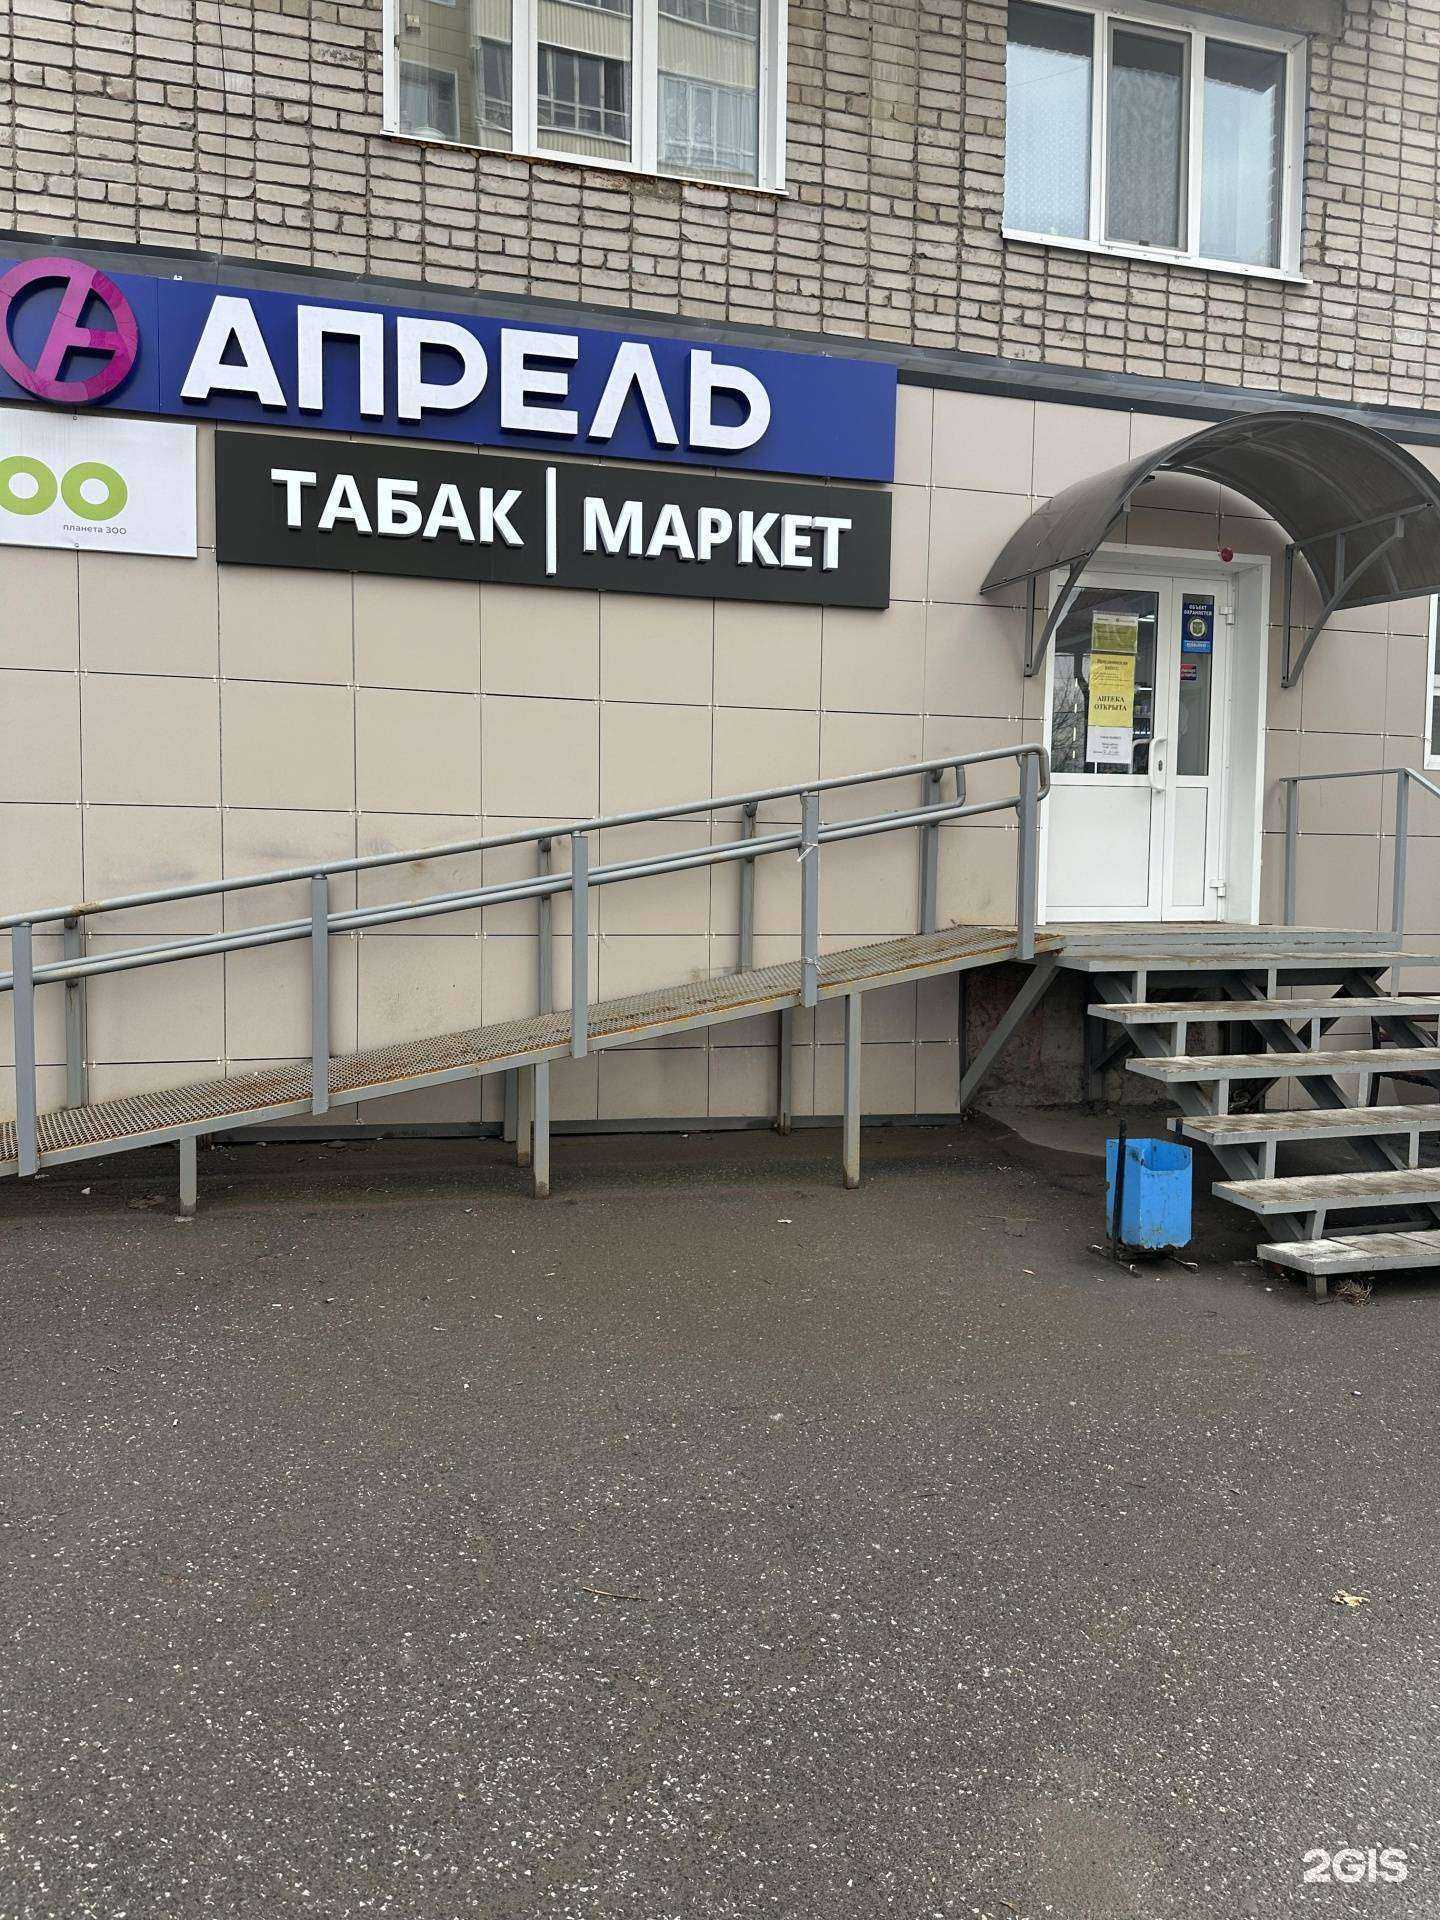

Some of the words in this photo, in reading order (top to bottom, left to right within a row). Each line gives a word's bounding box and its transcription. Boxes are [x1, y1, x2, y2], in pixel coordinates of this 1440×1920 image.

[180, 295, 771, 450] АПРЕЛЬ
[270, 467, 525, 547] ТАБАК
[583, 495, 852, 572] МАРКЕТ
[63, 523, 103, 534] планета
[1097, 695, 1125, 703] АПТЕКА
[1094, 703, 1127, 711] ОТКРЫТА
